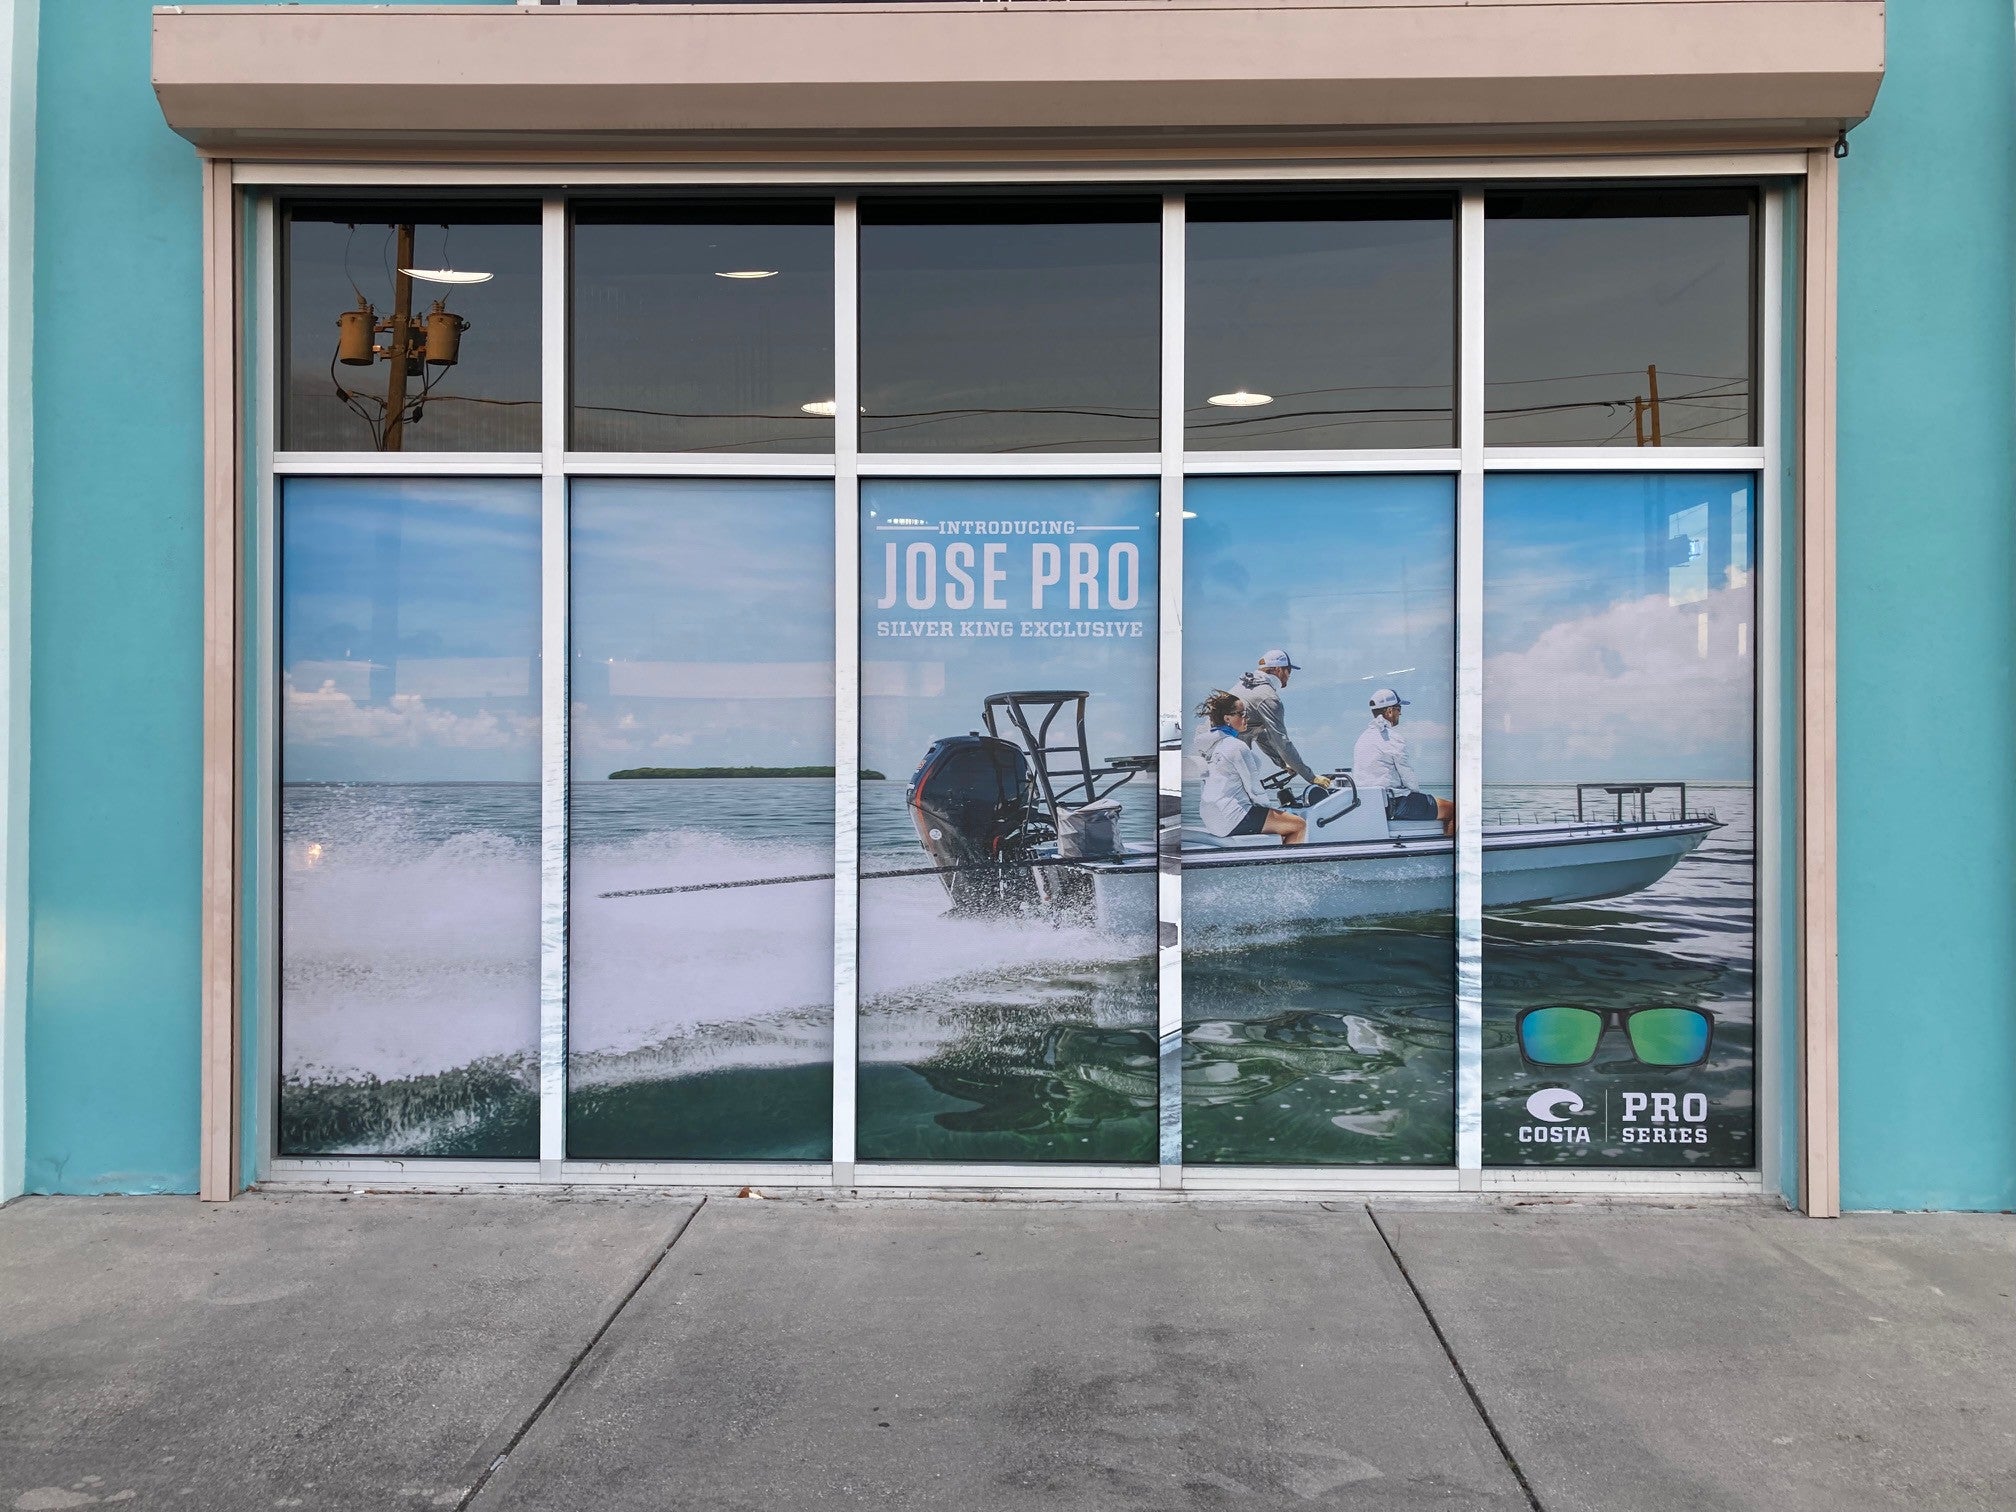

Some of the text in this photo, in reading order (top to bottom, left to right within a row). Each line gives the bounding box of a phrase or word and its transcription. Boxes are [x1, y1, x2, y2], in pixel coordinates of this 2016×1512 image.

[939, 521, 1075, 535] INTRODUCING
[877, 542, 1139, 610] JOSE PRO
[877, 621, 1143, 637] SILVER KING EXCLUSIVE
[1622, 1092, 1708, 1122] PRO
[1518, 1126, 1591, 1143] COSTA
[1622, 1127, 1708, 1143] SERIES
